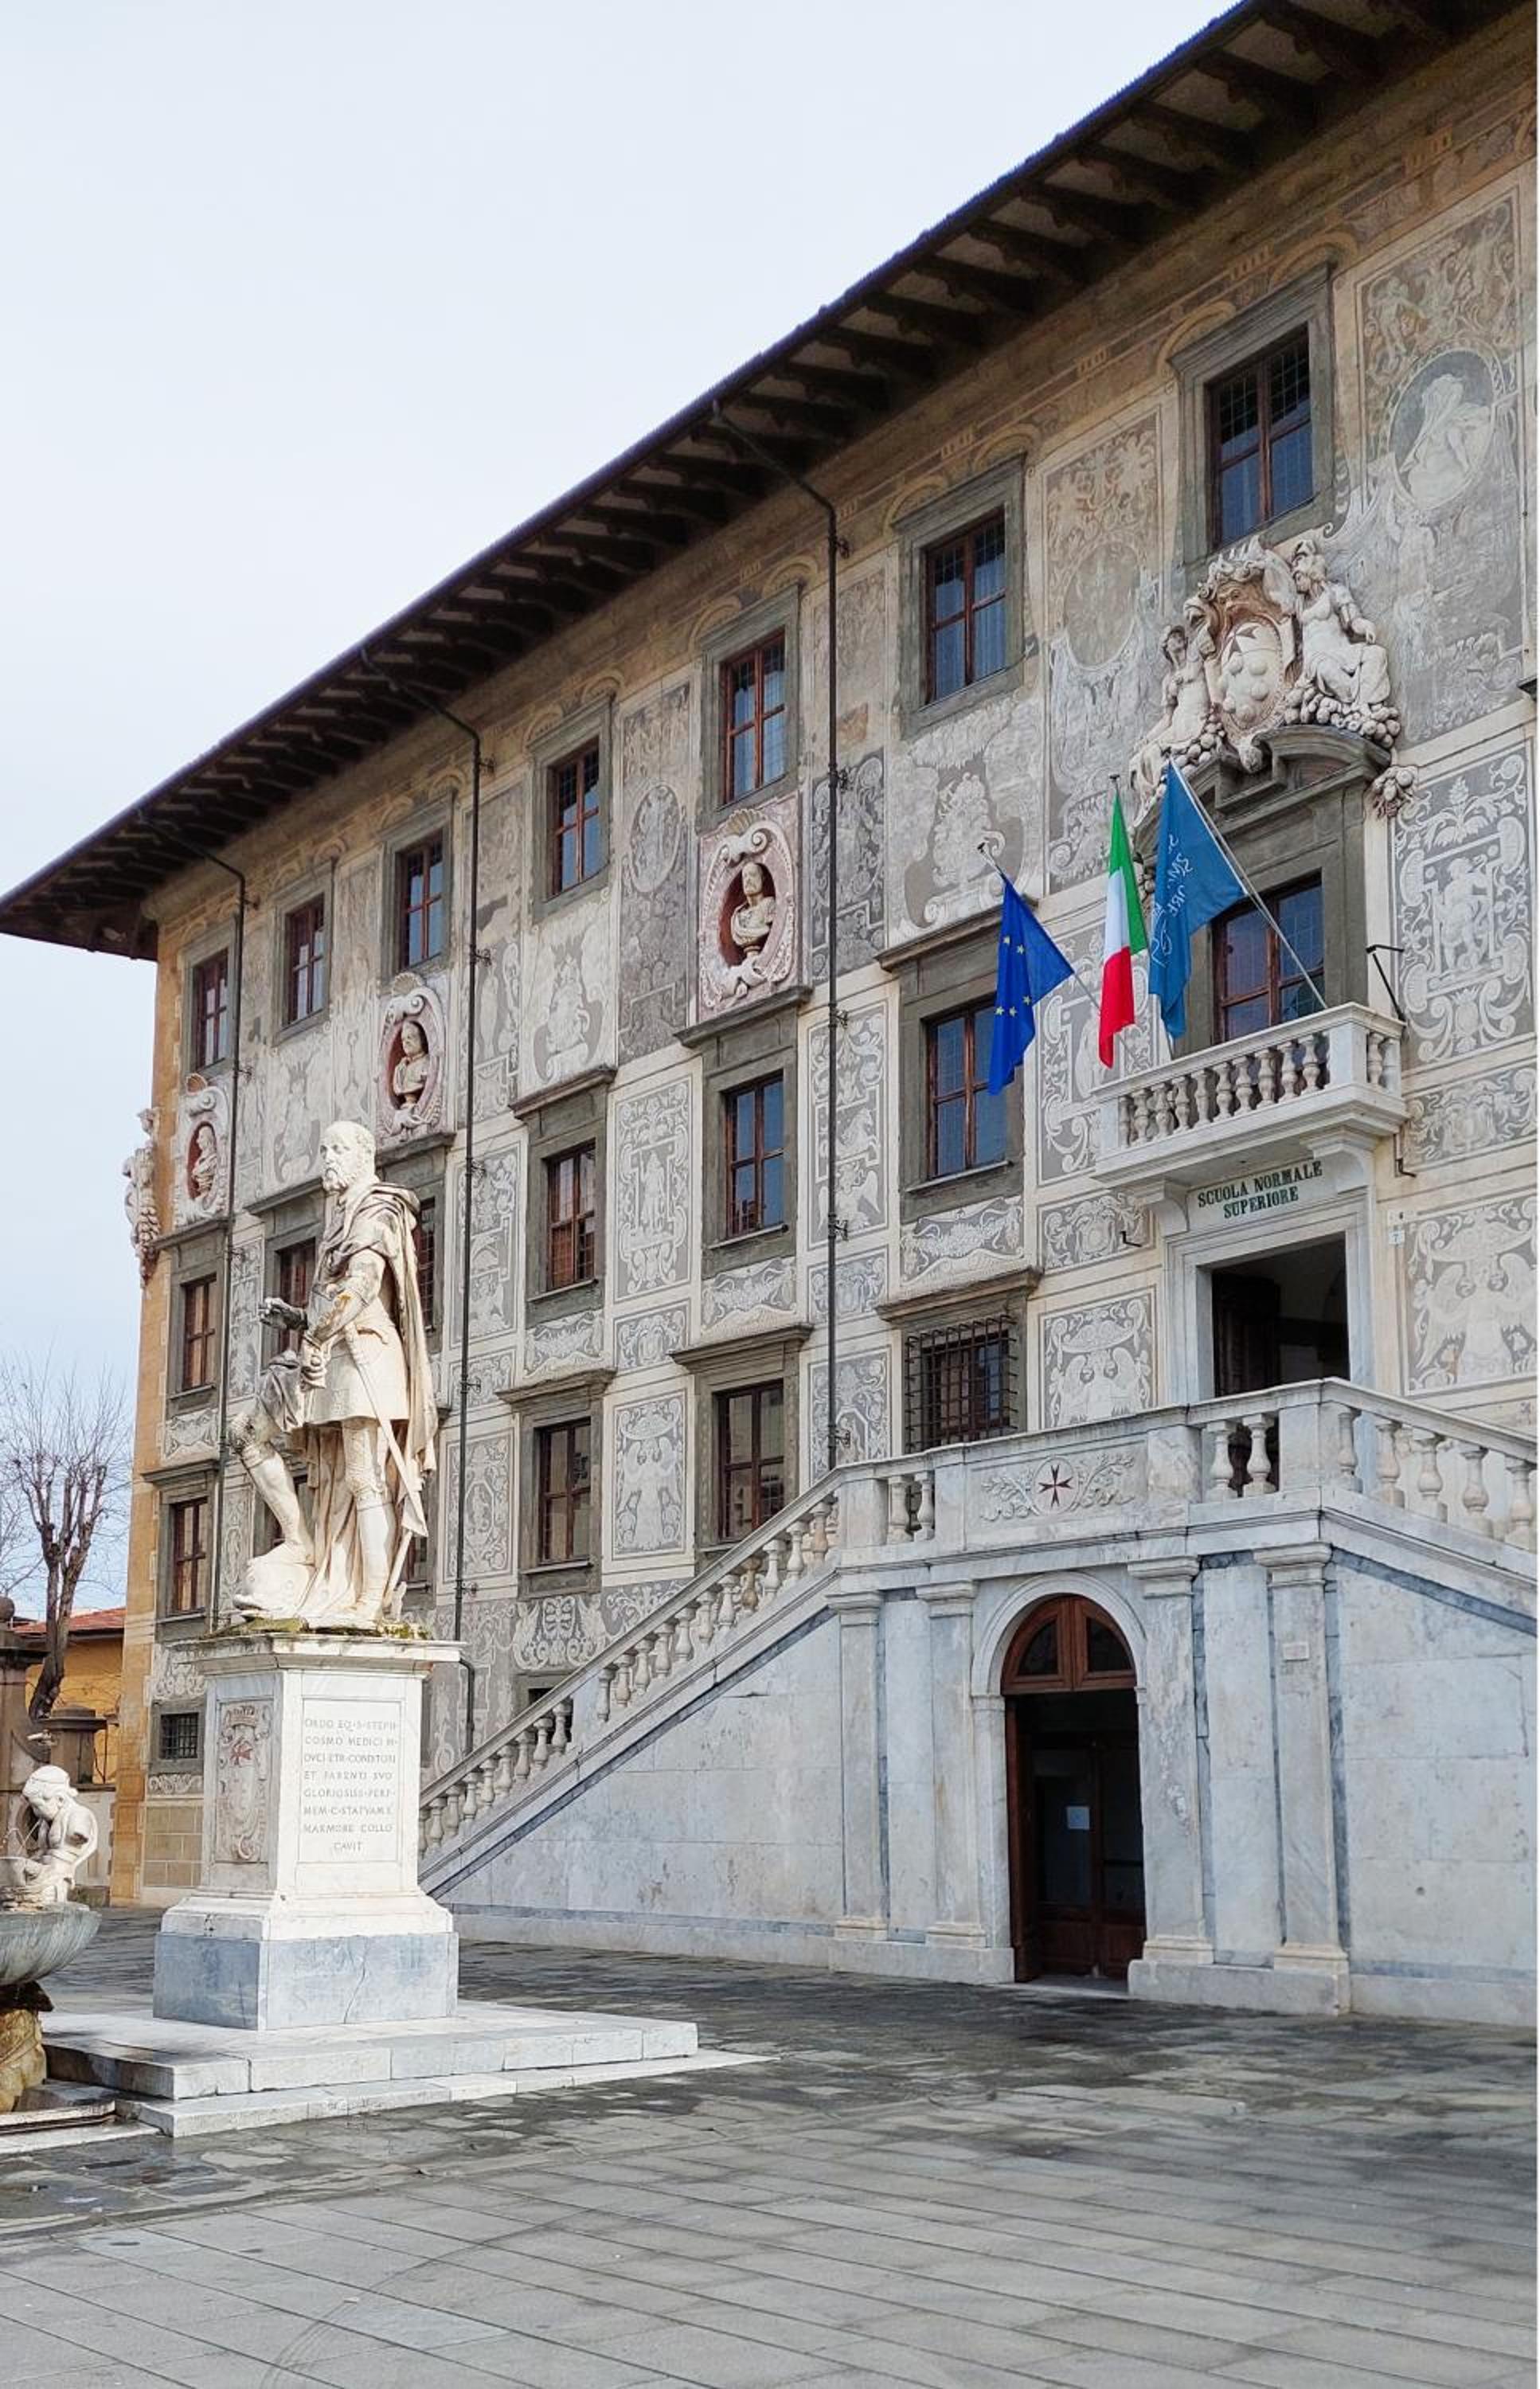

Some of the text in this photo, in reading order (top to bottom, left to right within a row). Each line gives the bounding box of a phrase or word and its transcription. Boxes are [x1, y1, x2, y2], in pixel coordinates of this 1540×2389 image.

[1198, 1160, 1323, 1207] SCUOLA NORMALE
[1223, 1186, 1300, 1218] SUPERIORE
[305, 1735, 343, 1746] COSMO
[348, 1736, 382, 1746] MEDICI
[304, 1770, 393, 1781] ET PARENTI SVO
[303, 1823, 393, 1833] MARMORE COLLO
[333, 1840, 363, 1851] CAVIT
